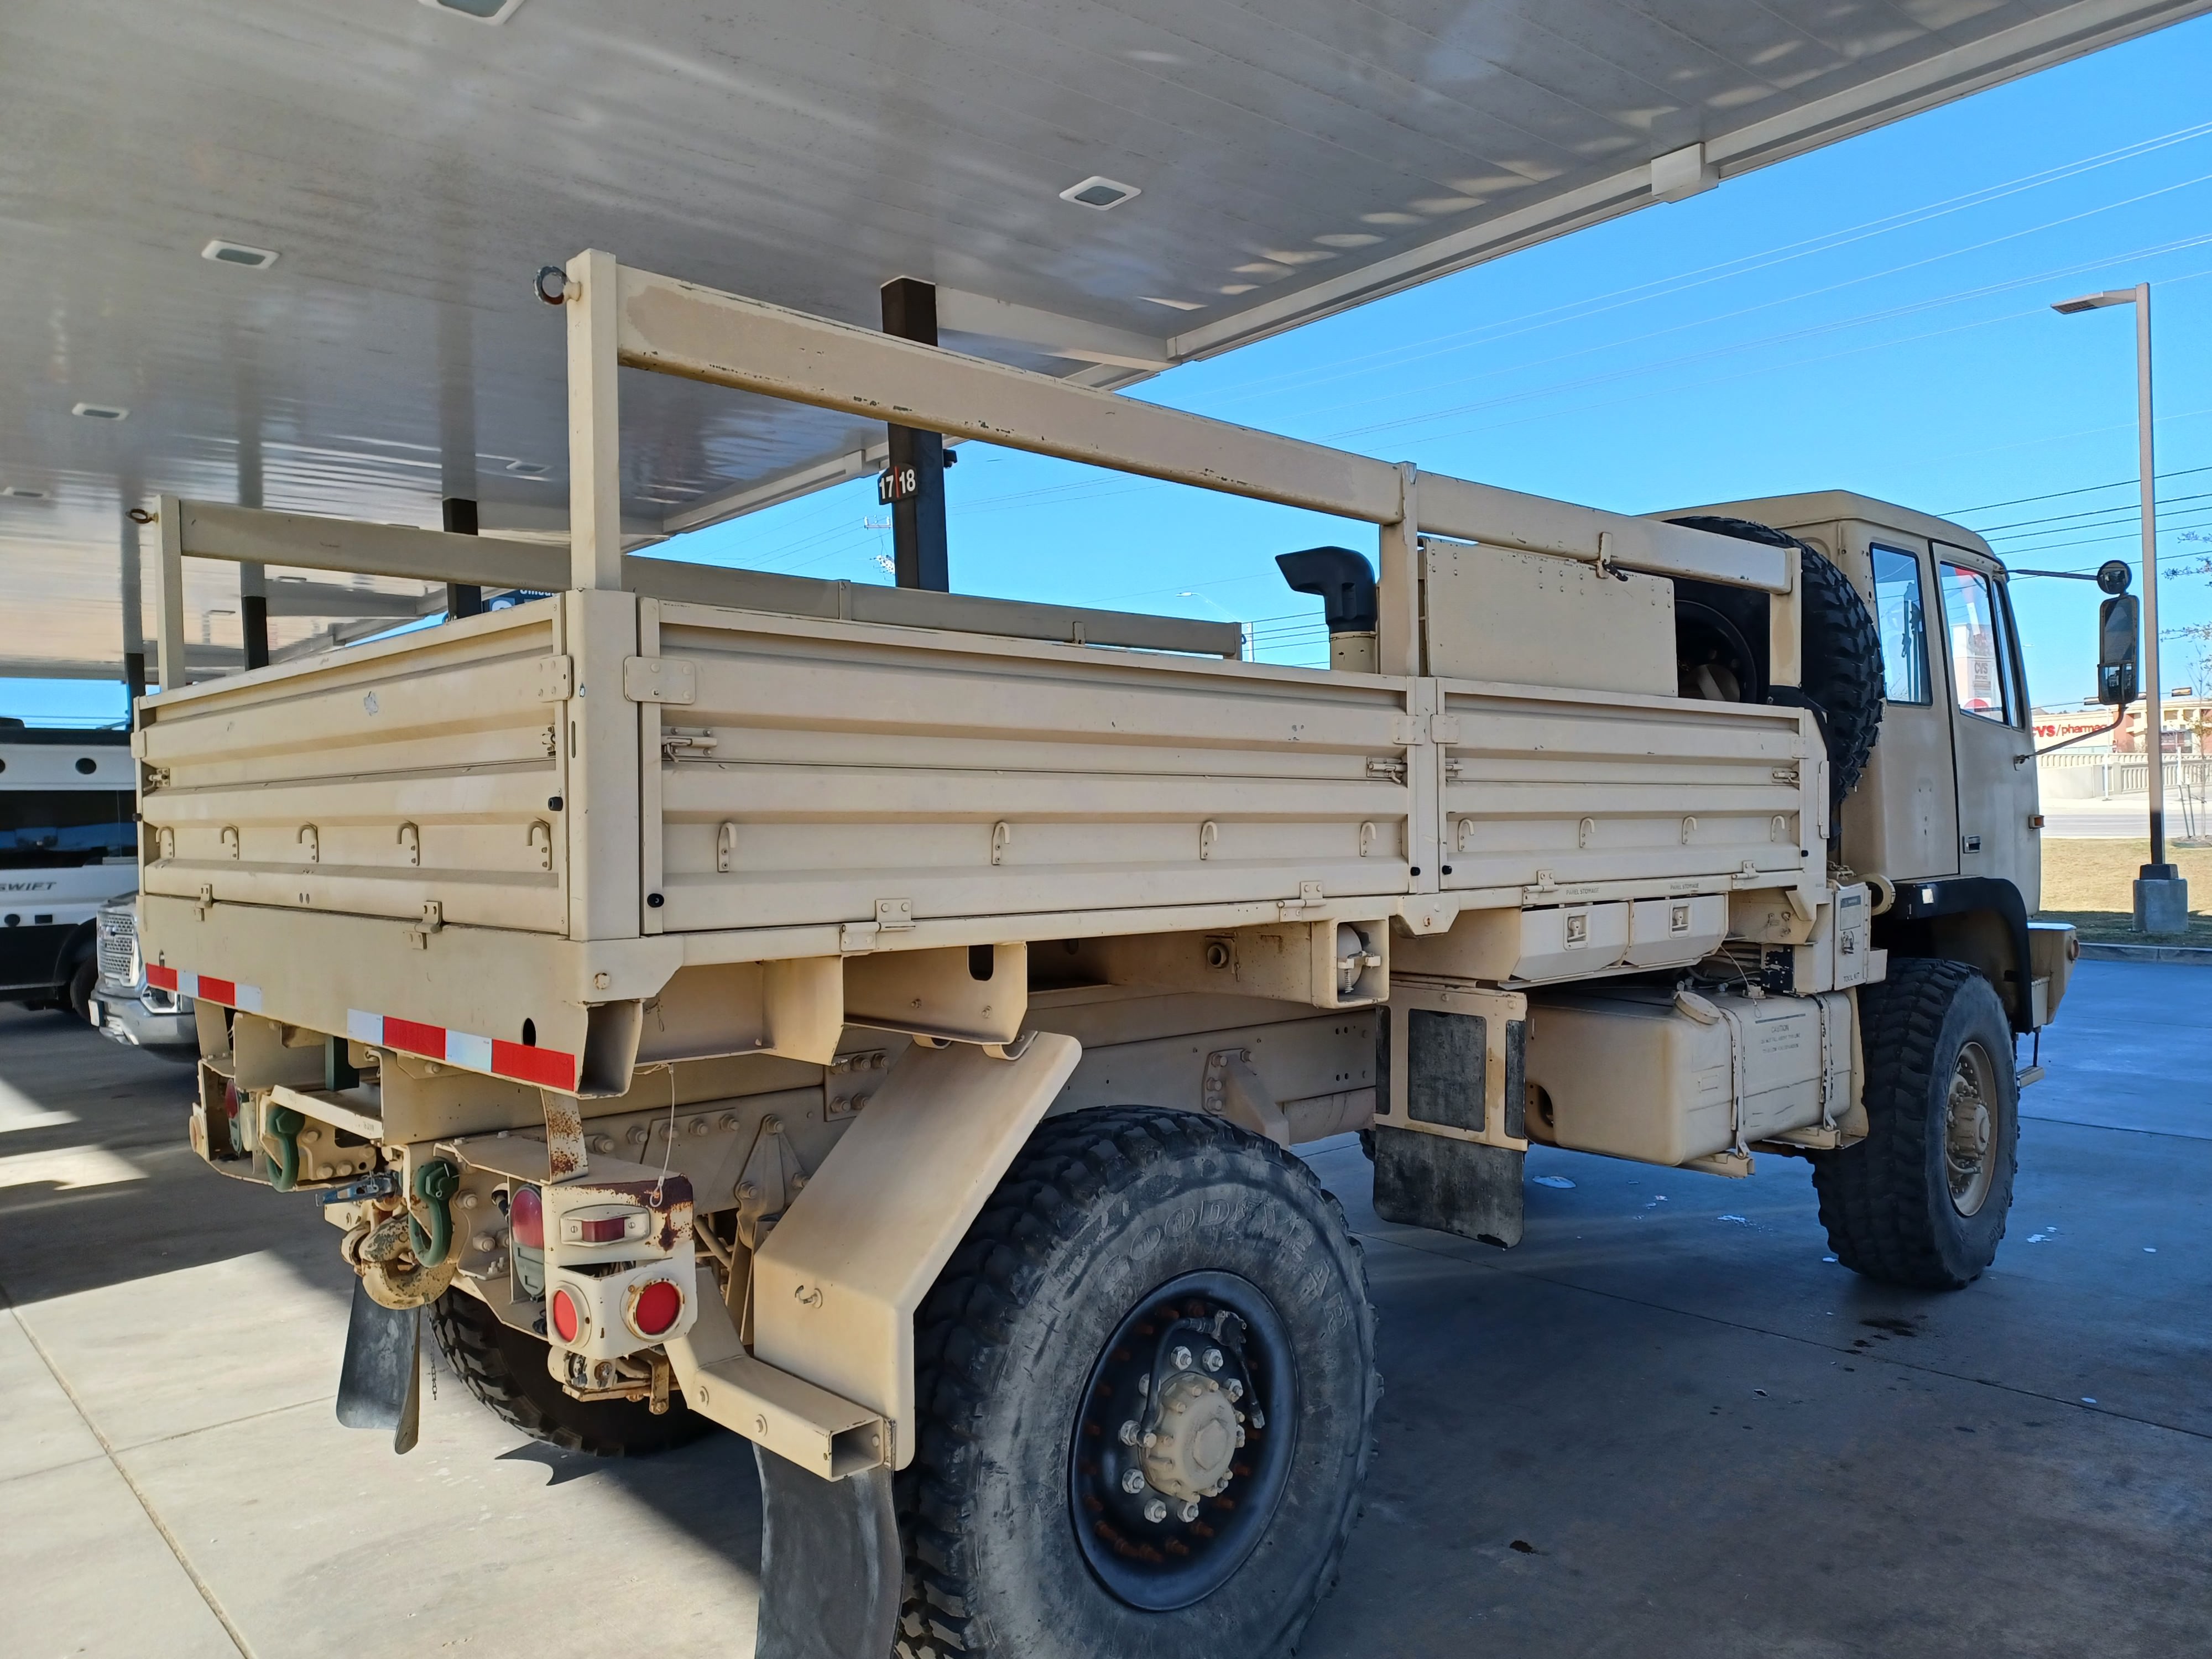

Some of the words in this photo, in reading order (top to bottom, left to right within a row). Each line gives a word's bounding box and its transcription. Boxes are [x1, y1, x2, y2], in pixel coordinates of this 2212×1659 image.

[879, 474, 894, 499] 17
[899, 469, 916, 494] 18
[1974, 662, 1988, 674] CVS
